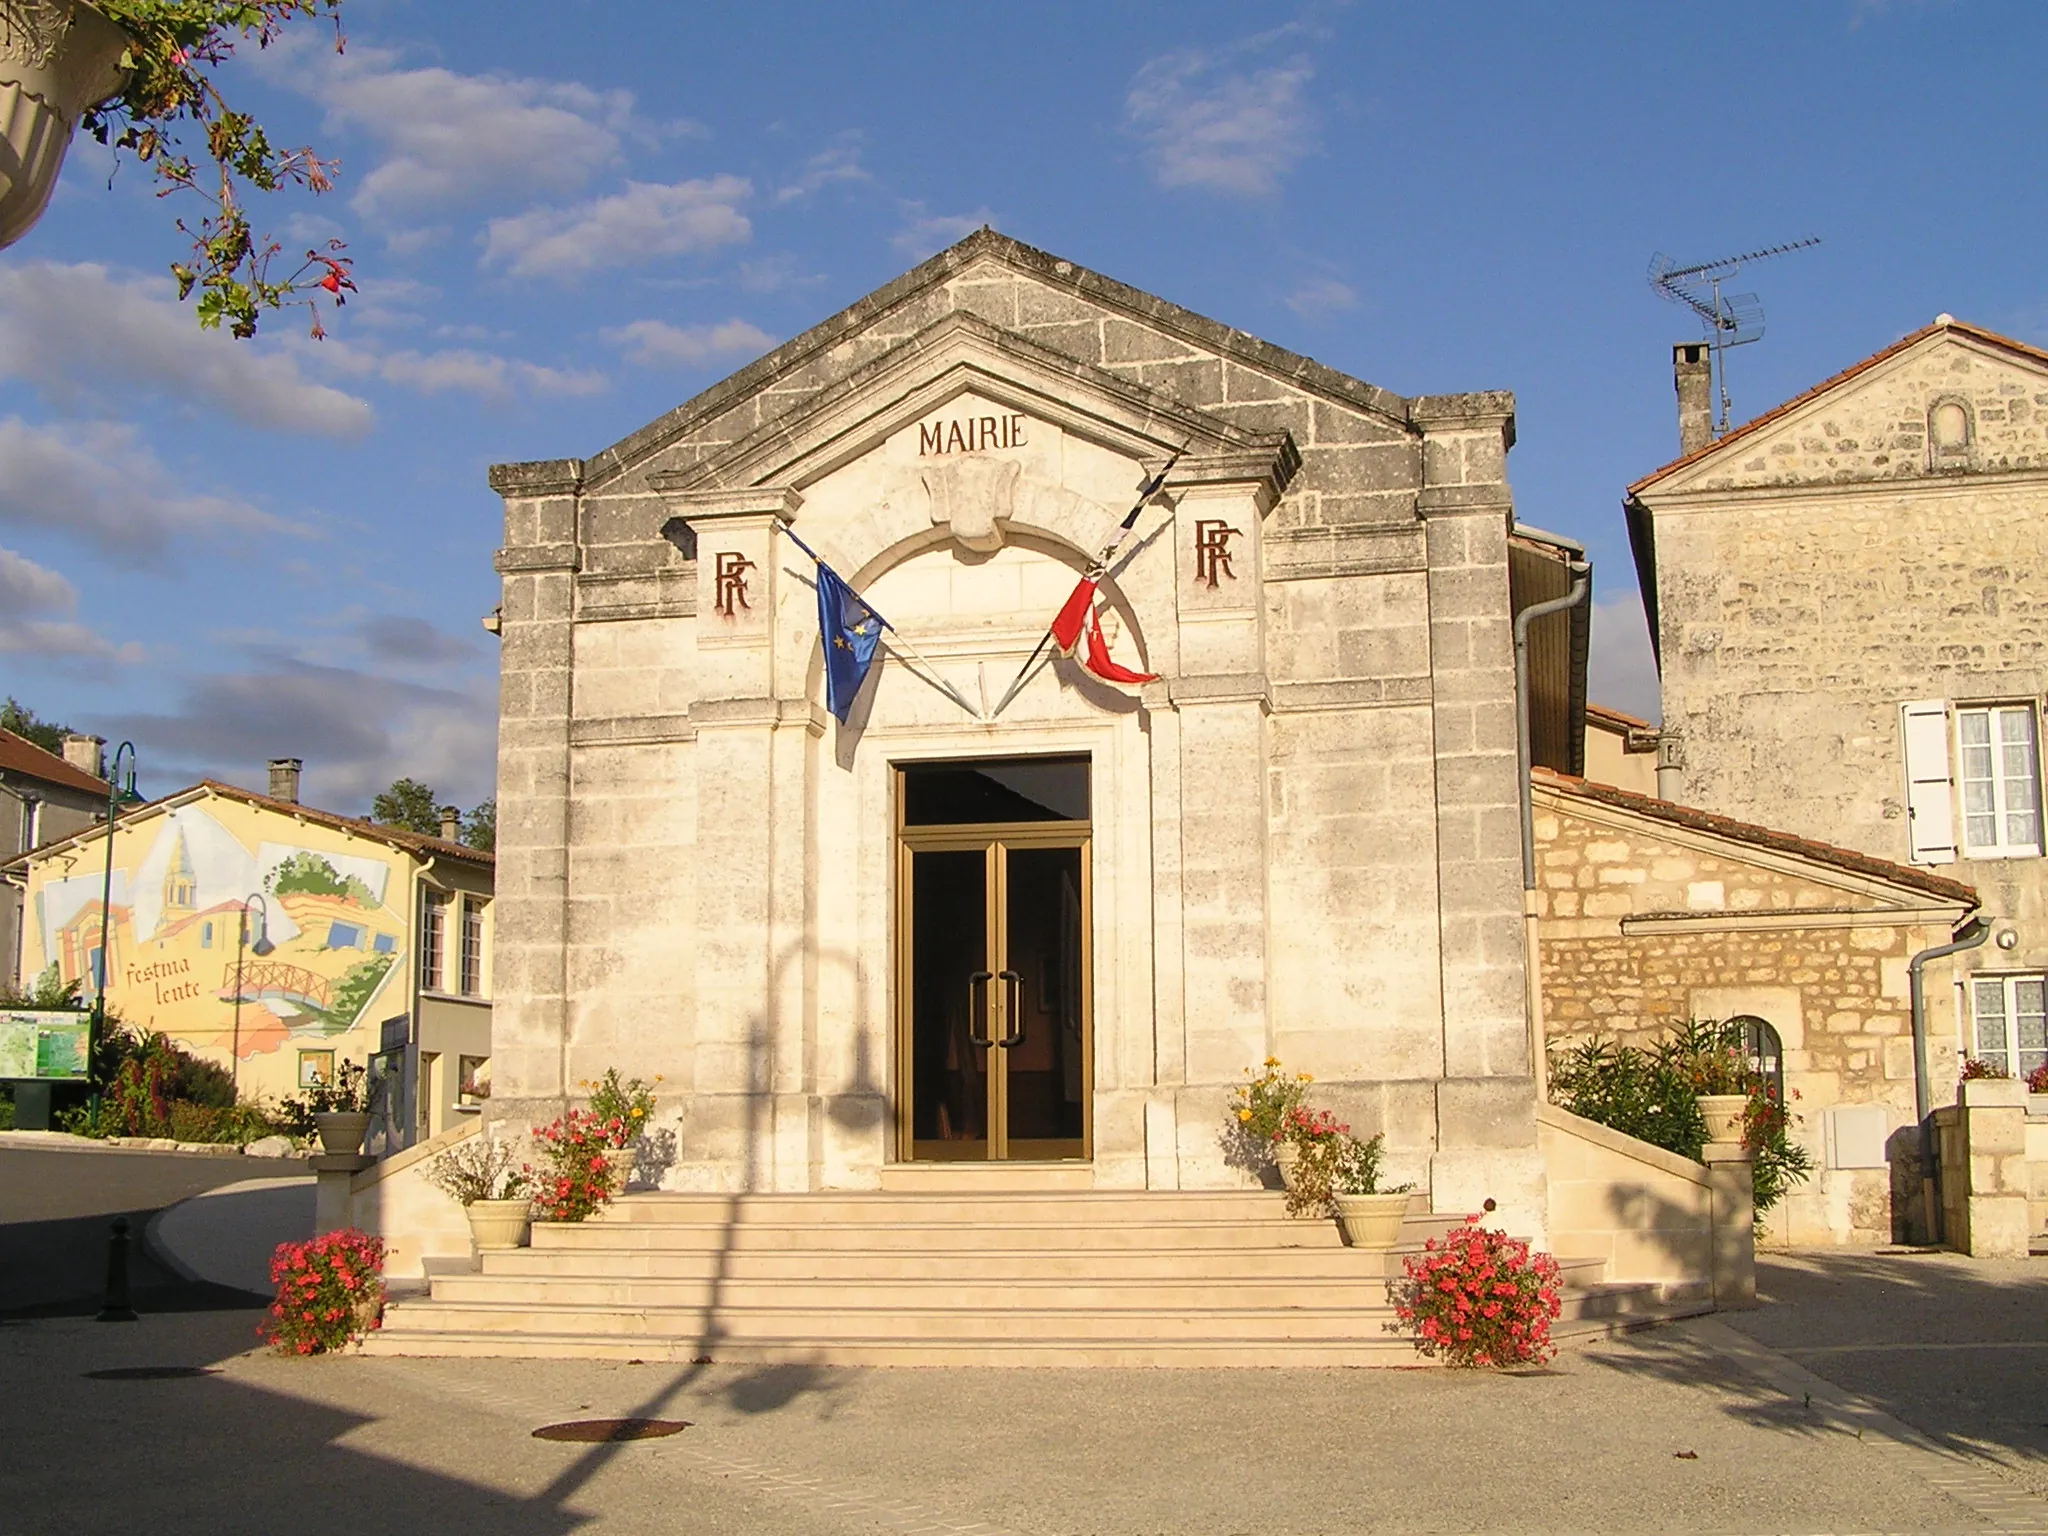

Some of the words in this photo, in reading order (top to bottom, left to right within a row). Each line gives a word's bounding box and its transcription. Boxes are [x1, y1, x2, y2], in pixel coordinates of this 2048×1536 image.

[918, 413, 1029, 456] MAIRIE
[126, 958, 190, 990] festina
[155, 981, 200, 1005] lente
